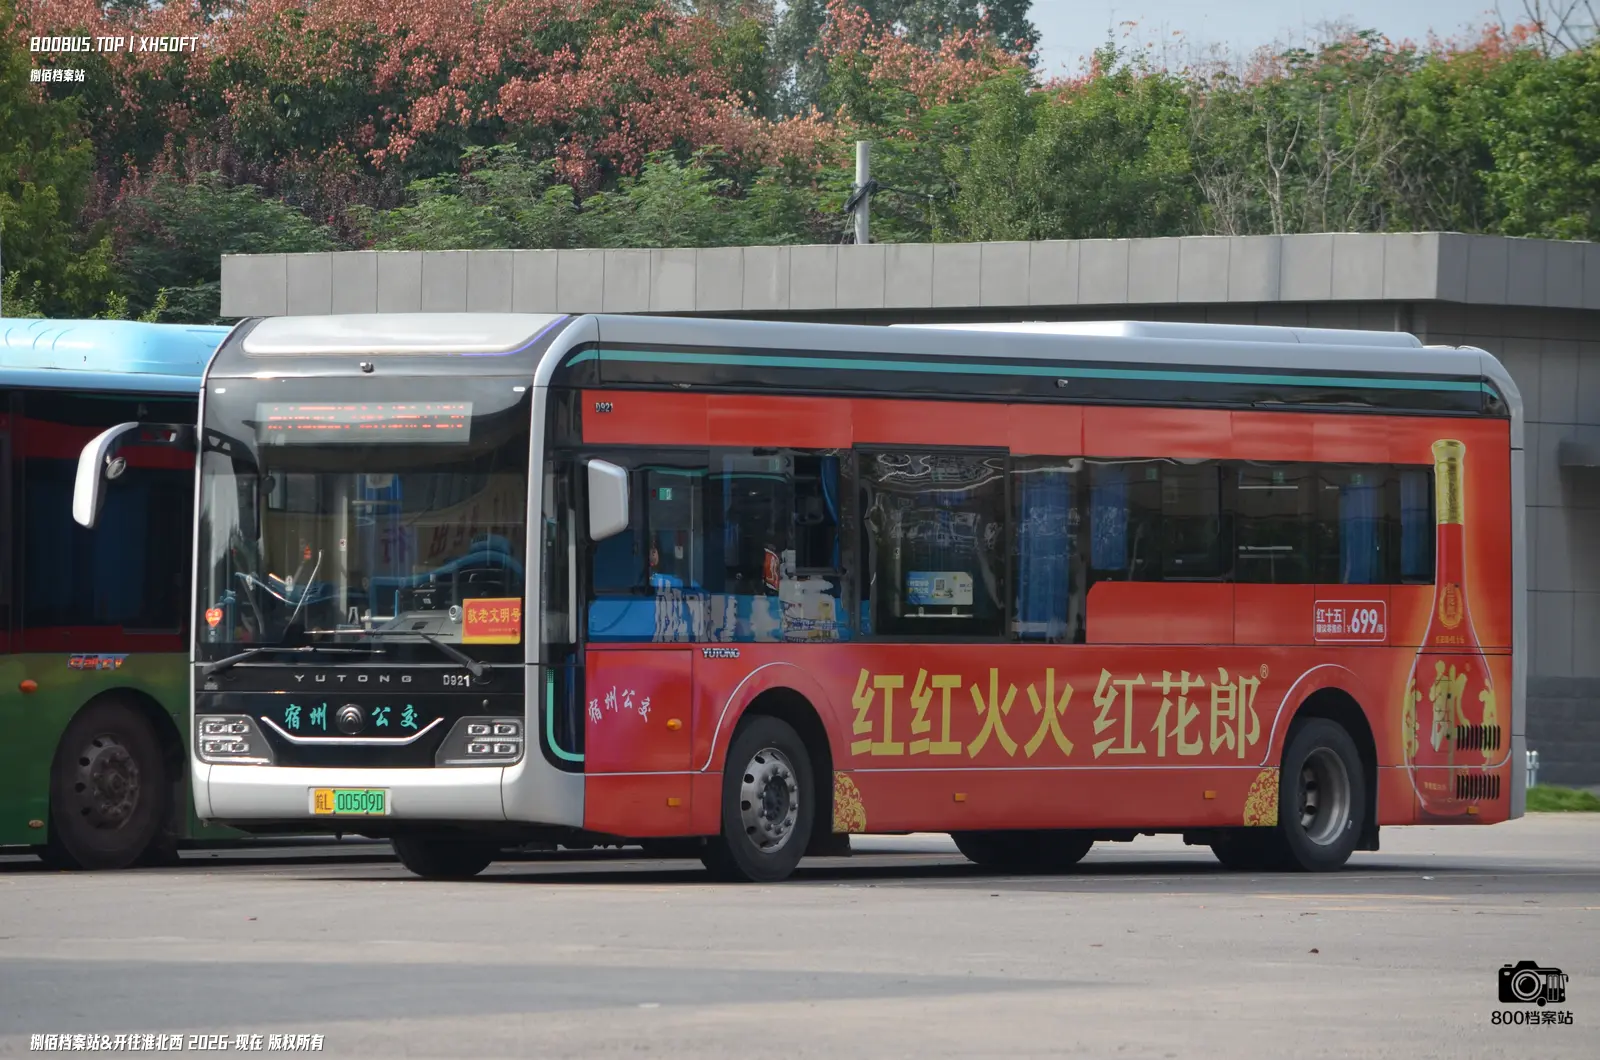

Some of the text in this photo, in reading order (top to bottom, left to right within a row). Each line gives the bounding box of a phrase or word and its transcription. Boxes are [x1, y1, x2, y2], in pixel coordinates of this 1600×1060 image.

[595, 402, 613, 413] D921
[467, 607, 521, 624] 敬老文明号
[1316, 608, 1342, 623] 红十五
[702, 648, 740, 659] YUTONG
[294, 674, 412, 683] YUTONG
[443, 674, 471, 687] D921
[850, 667, 1074, 759] 红红火火
[337, 793, 384, 811] 00509D
